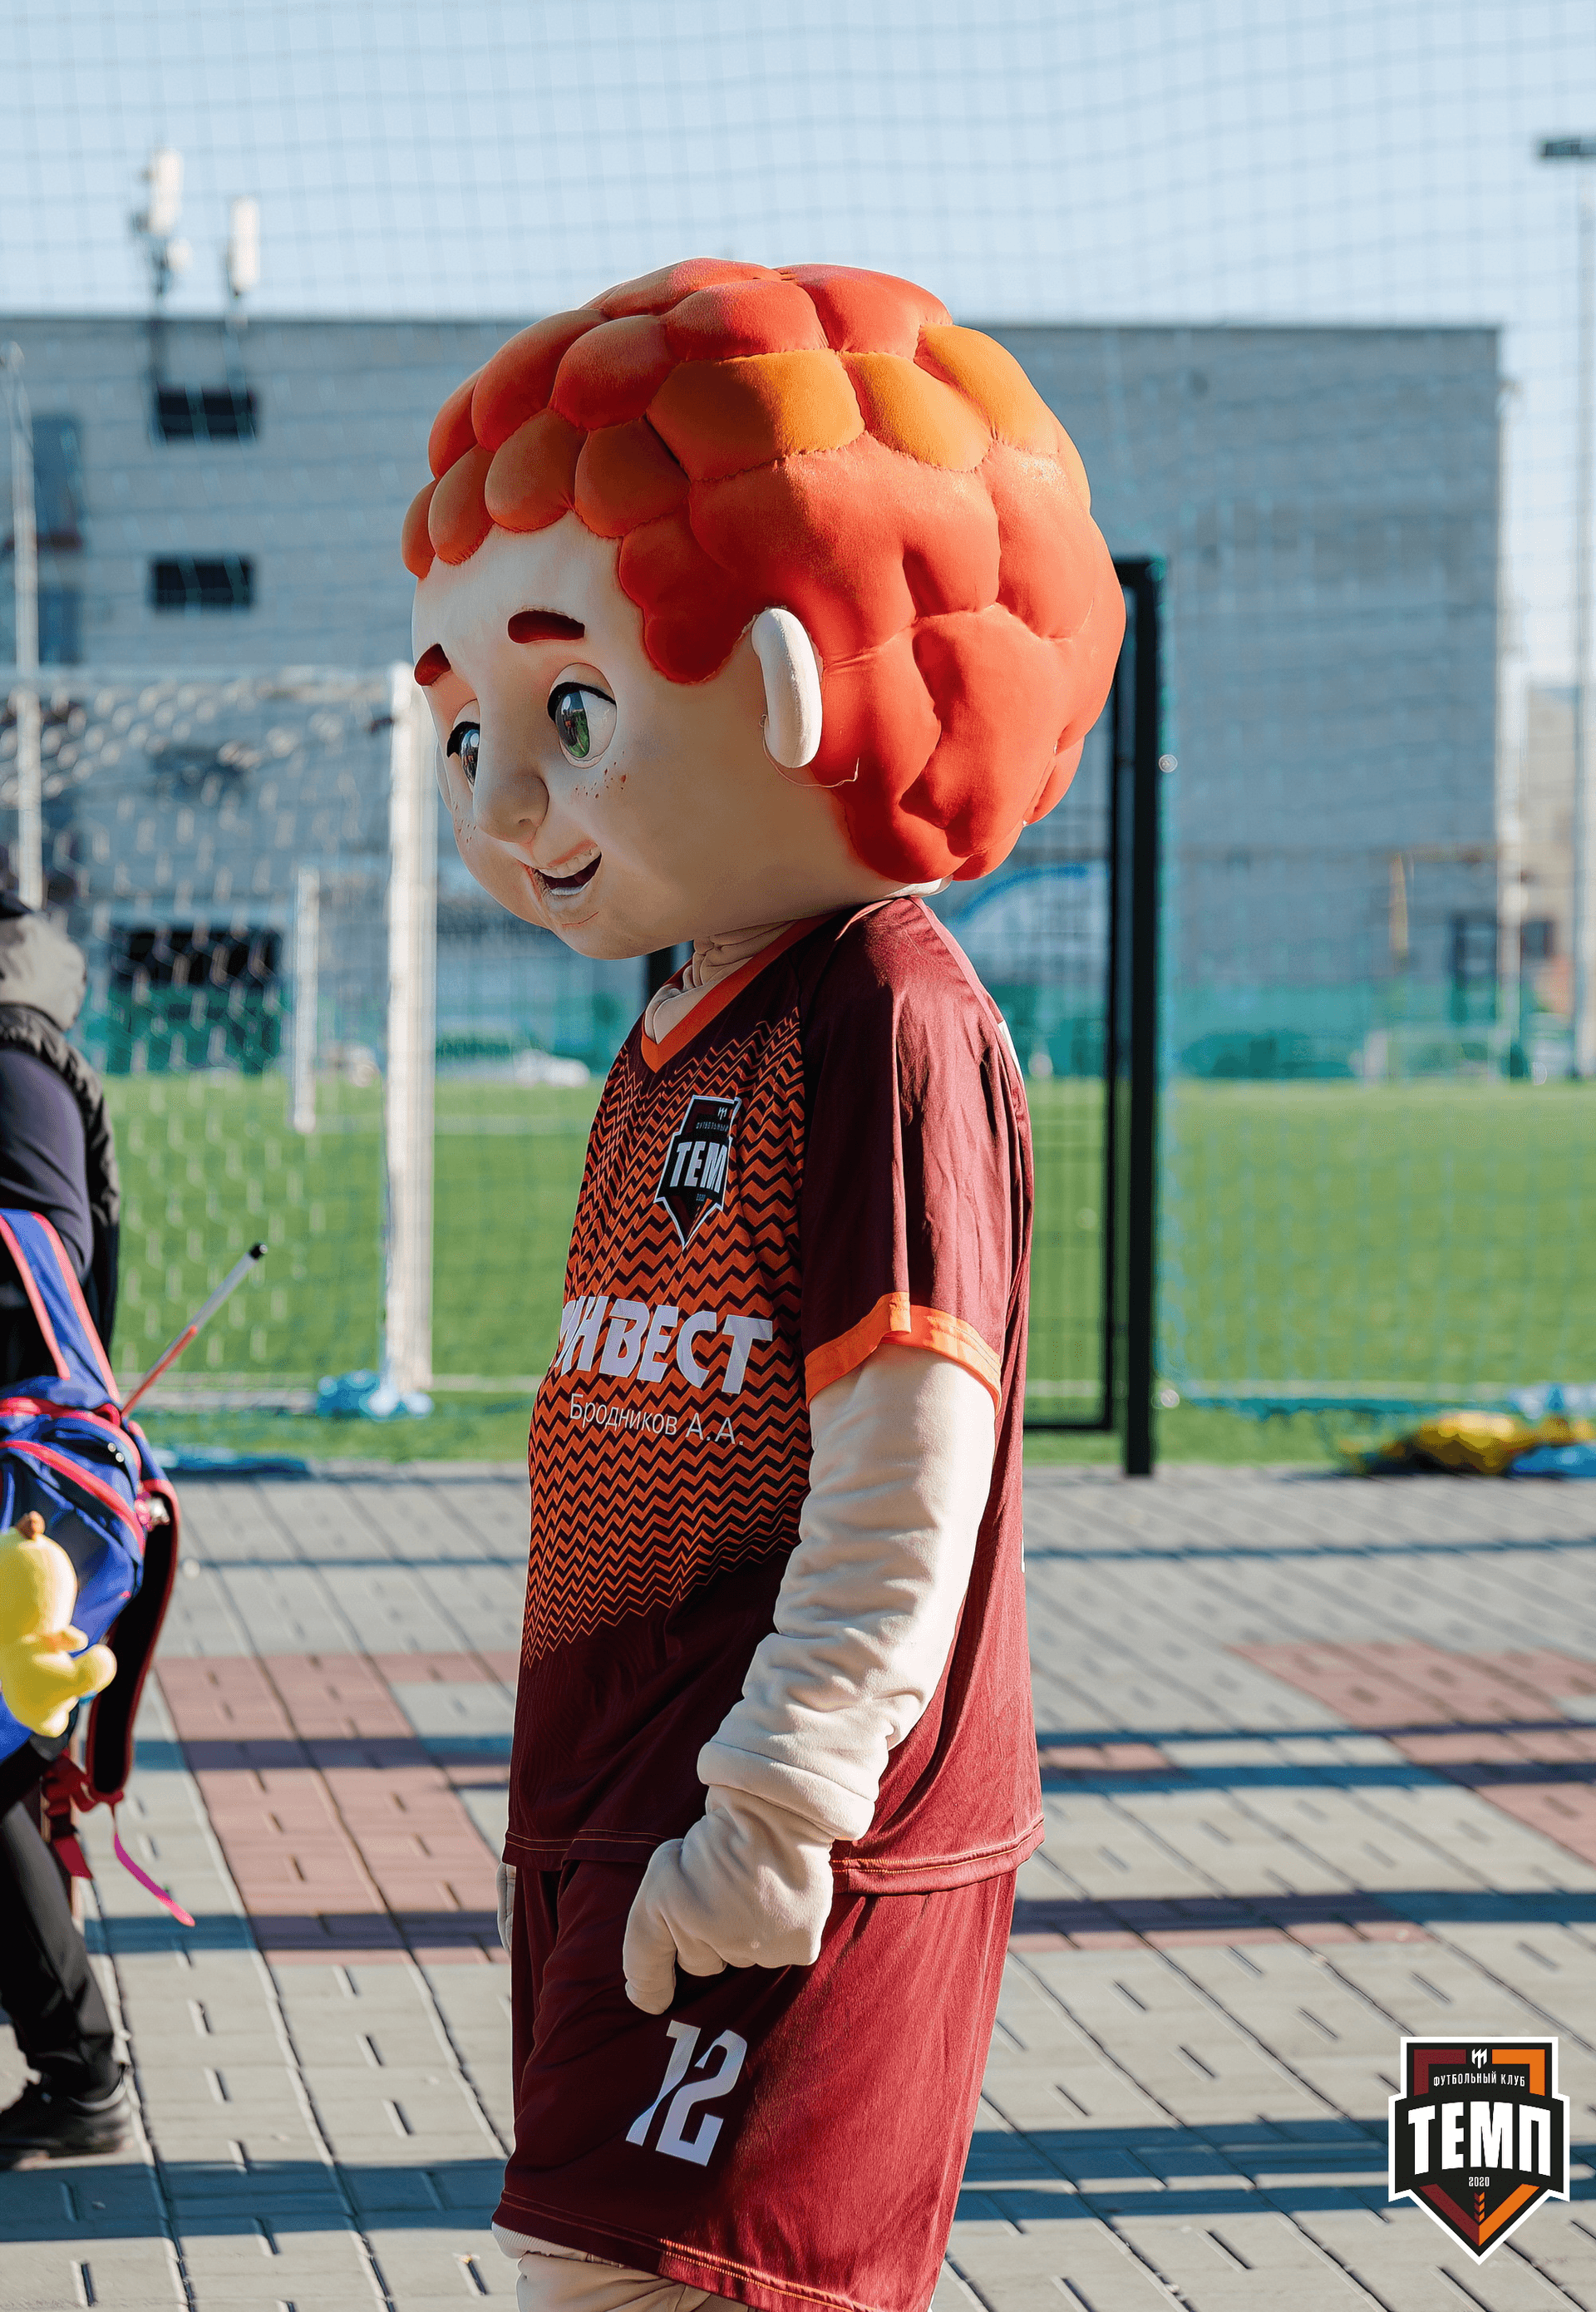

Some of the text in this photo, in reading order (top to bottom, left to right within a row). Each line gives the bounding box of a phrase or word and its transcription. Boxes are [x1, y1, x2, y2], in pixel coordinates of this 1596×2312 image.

[569, 1393, 745, 1446] Бродников А.А.
[625, 2019, 748, 2167] 12
